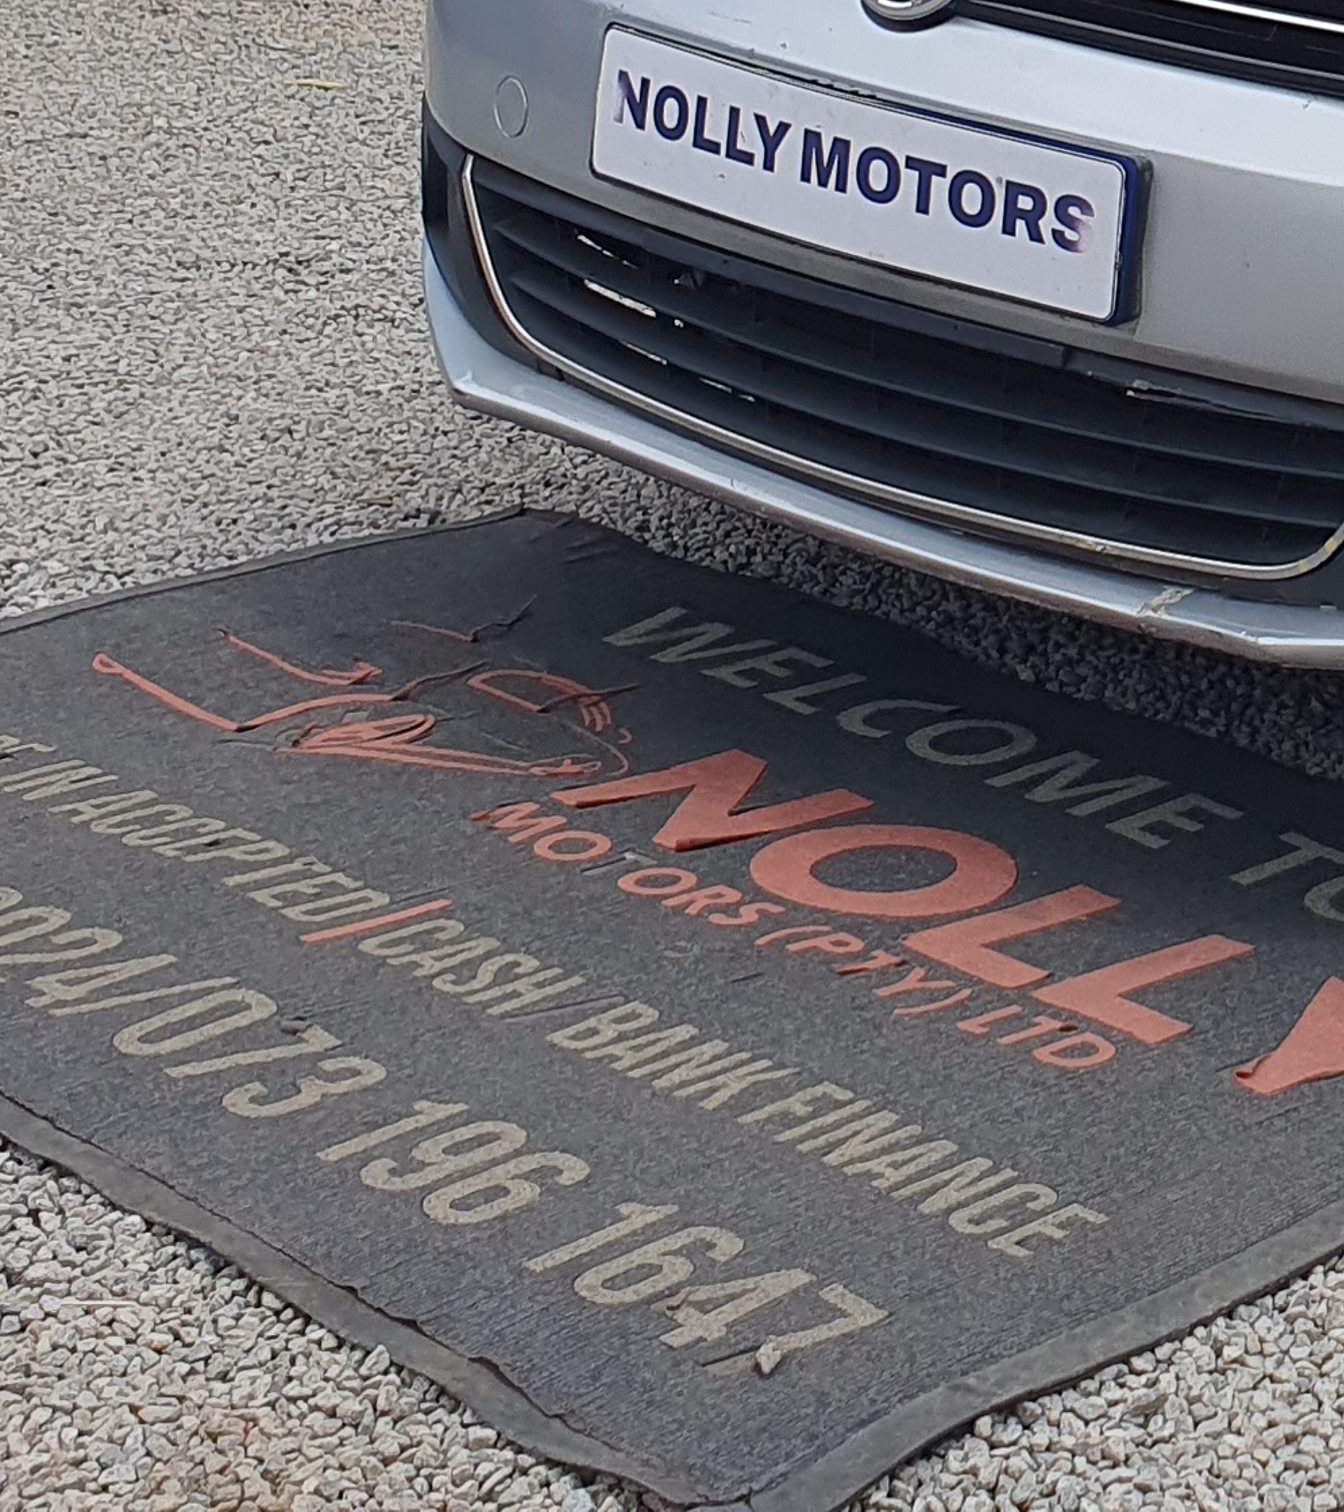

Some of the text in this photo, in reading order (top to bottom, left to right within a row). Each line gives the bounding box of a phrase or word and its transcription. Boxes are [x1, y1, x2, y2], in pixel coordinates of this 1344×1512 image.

[613, 70, 1095, 253] NOLLY MOTORS
[603, 607, 1244, 849] WELCOME
[956, 1005, 1116, 1069] LTD
[316, 1099, 591, 1226] 196
[524, 1201, 891, 1376] 1647
[737, 1080, 1109, 1258] FINANCE
